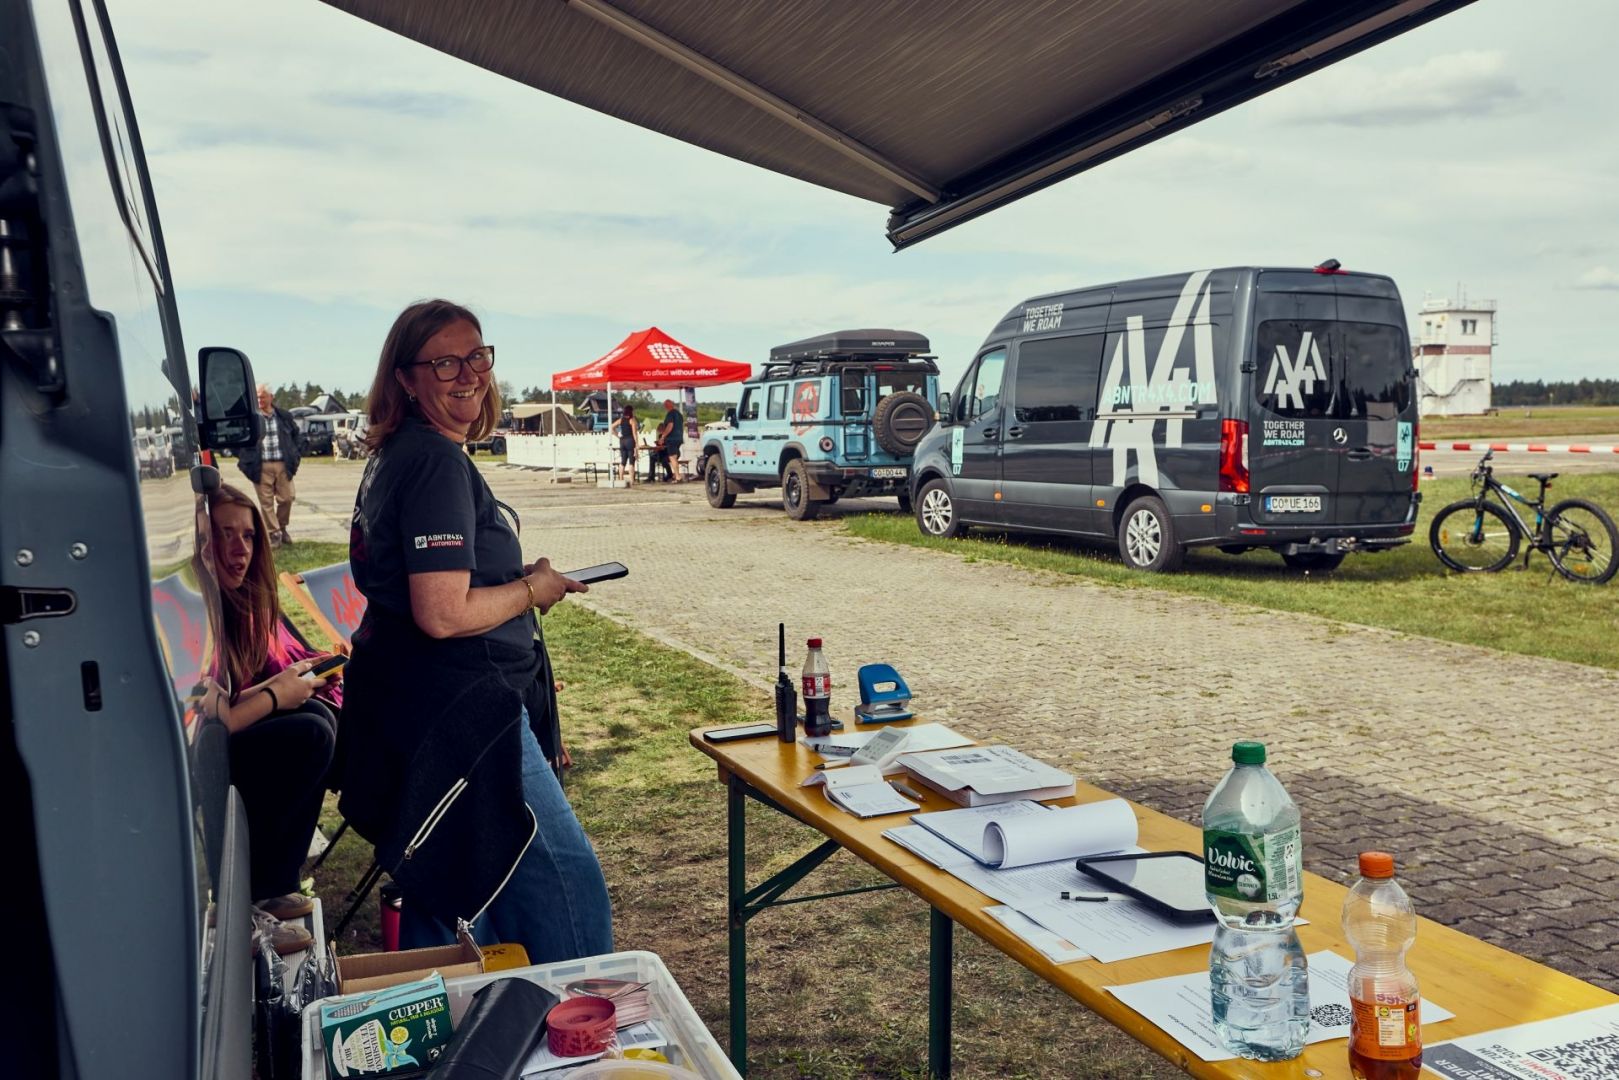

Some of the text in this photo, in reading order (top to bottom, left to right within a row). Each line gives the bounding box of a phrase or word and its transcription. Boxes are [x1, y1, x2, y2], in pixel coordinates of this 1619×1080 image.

[1026, 303, 1064, 319] TOGETHER
[1023, 316, 1062, 332] WE ROAM
[670, 368, 694, 376] without
[1264, 420, 1304, 430] TOGETHER
[1264, 430, 1305, 439] WE ROAM
[953, 464, 962, 475] 07
[1398, 460, 1410, 472] 07
[388, 997, 443, 1021] CUPPER
[367, 1022, 382, 1070] REFRESHING
[1434, 1059, 1481, 1080] ADIER
